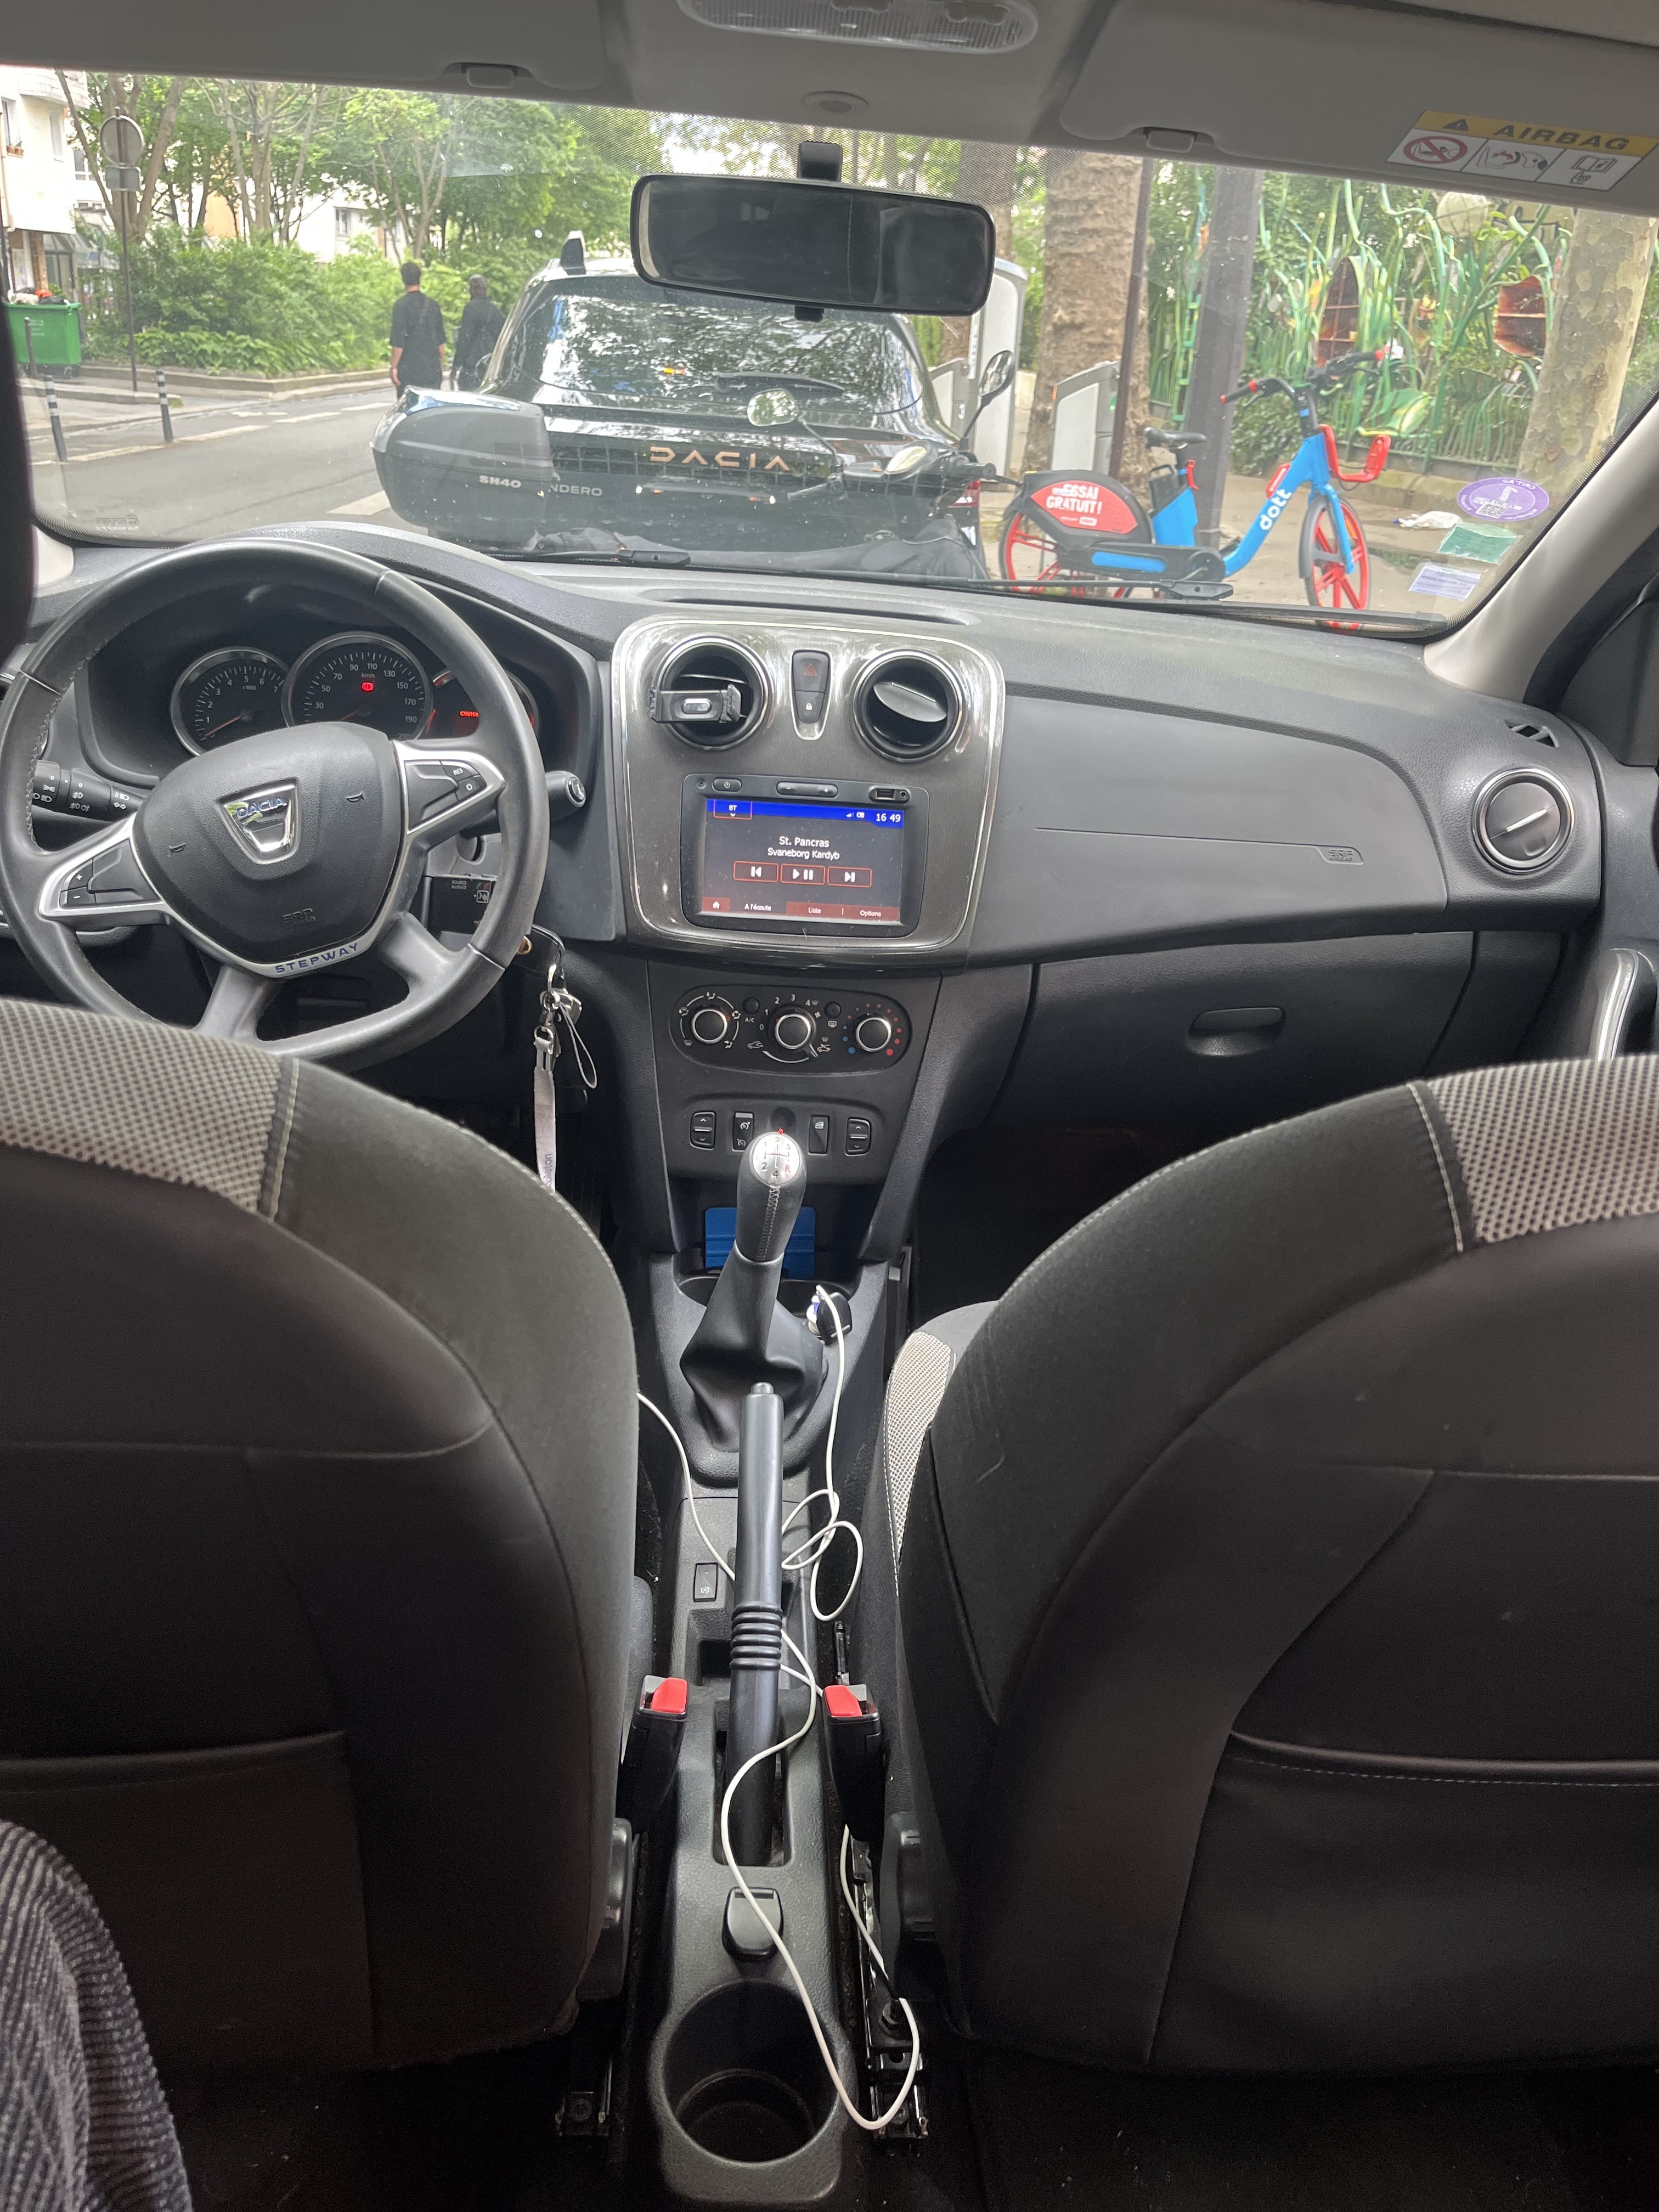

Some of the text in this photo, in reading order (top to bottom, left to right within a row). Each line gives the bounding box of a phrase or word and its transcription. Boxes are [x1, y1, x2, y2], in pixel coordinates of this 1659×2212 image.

[1492, 125, 1629, 150] AIRBAG
[650, 447, 791, 471] DACIA
[479, 475, 522, 488] SH40
[1260, 489, 1293, 531] dott
[236, 798, 288, 819] DACIA
[779, 836, 830, 848] St. Pancras
[768, 847, 840, 861] Svaneborg Kardyb
[275, 943, 358, 973] STEPWAY
[761, 1162, 767, 1170] 2
[785, 1164, 791, 1173] R
[772, 1170, 778, 1179] 4
